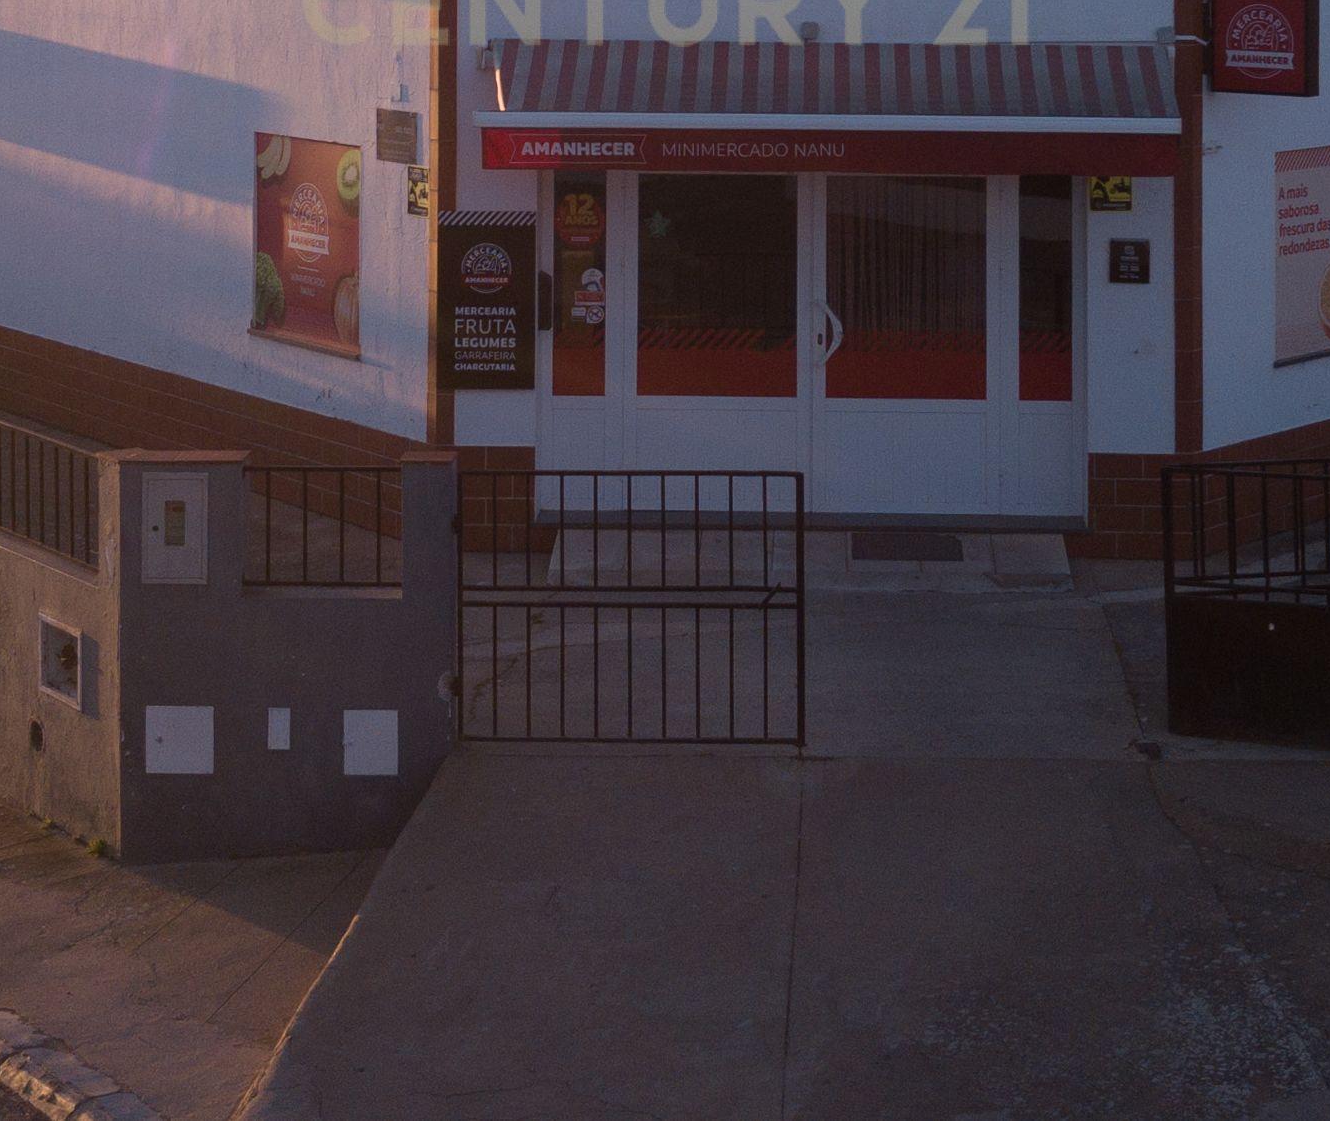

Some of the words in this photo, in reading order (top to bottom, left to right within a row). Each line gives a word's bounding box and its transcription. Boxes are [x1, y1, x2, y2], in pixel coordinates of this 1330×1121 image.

[1231, 9, 1289, 42] MERCEARIA
[1230, 53, 1290, 66] AMANHECER
[520, 141, 636, 158] AMANHECER
[662, 142, 789, 159] MINIMERCADO
[794, 142, 846, 159] NANU
[1278, 186, 1285, 201] A
[1286, 183, 1309, 200] mais
[564, 194, 595, 216] 12
[1278, 204, 1320, 220] saborosa
[1279, 222, 1316, 239] frescura
[465, 246, 509, 269] MERCEARIA
[464, 277, 509, 285] AMANHECER
[454, 306, 517, 317] MERCEARIA
[454, 319, 517, 335] FRUTA
[454, 337, 517, 349] LEGUMES
[454, 351, 517, 361] GARRAFEIRA
[454, 363, 516, 372] CHARCUTARIA
